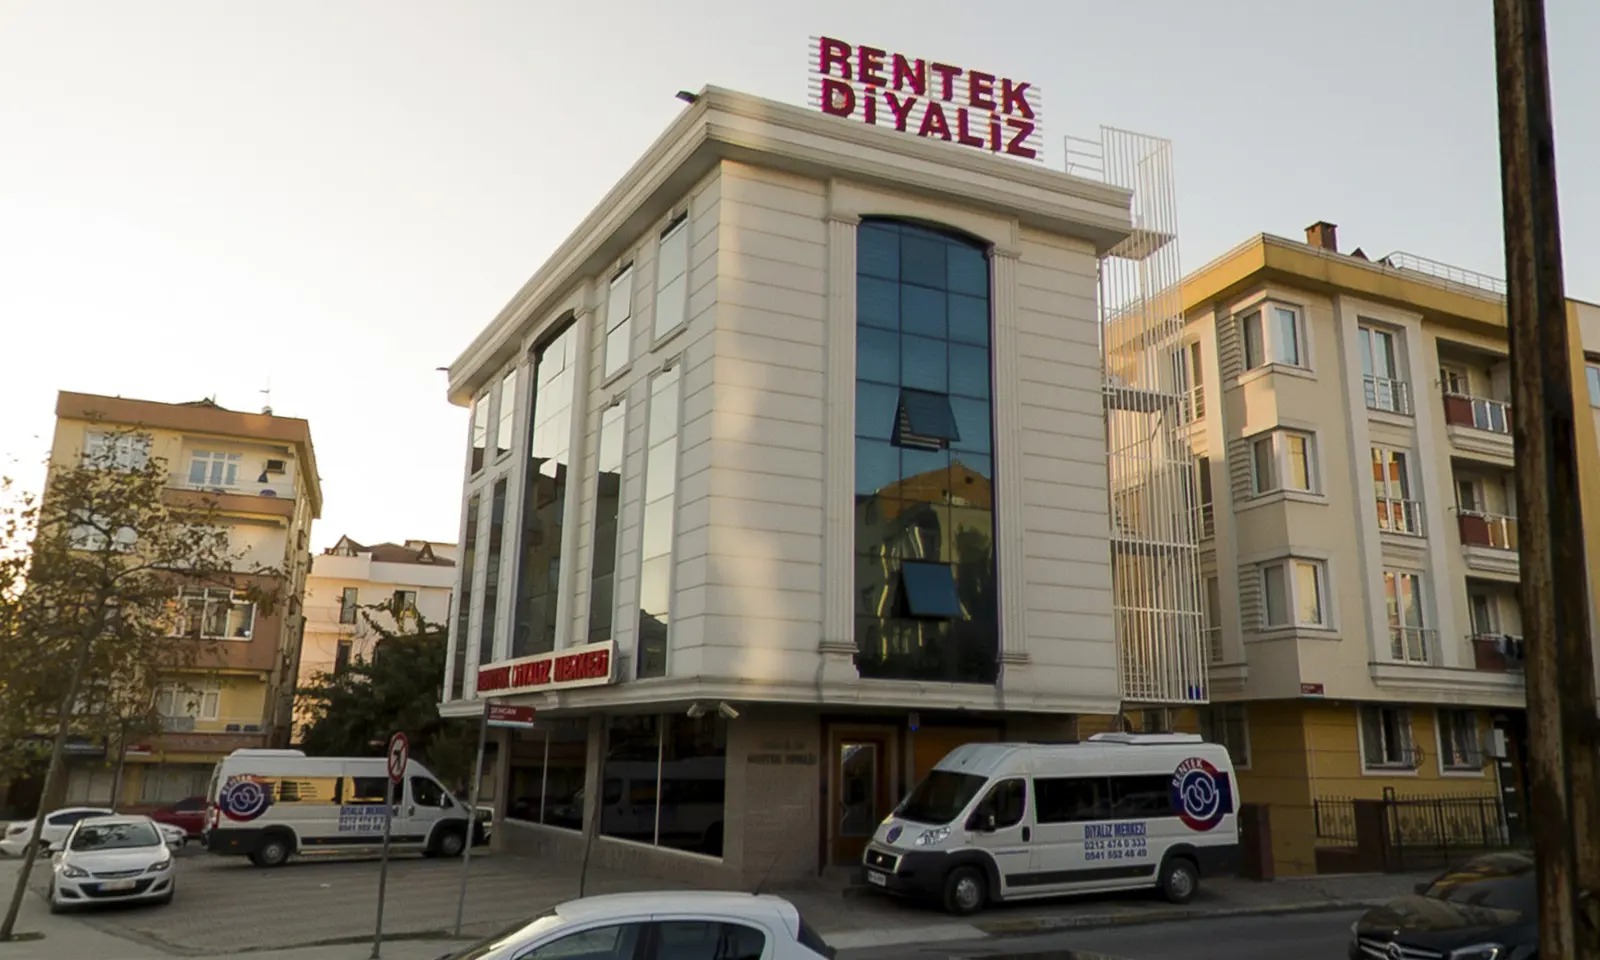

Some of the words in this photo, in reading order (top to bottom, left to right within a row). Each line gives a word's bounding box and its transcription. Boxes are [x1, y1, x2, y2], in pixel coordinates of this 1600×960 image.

[819, 36, 1036, 120] RENTEK
[821, 77, 1037, 160] DİYALİZ
[1172, 758, 1203, 788] RENTEK
[1084, 840, 1105, 850] 0212
[1107, 839, 1122, 849] 474
[1131, 838, 1146, 847] 333
[1084, 851, 1105, 860] 0541
